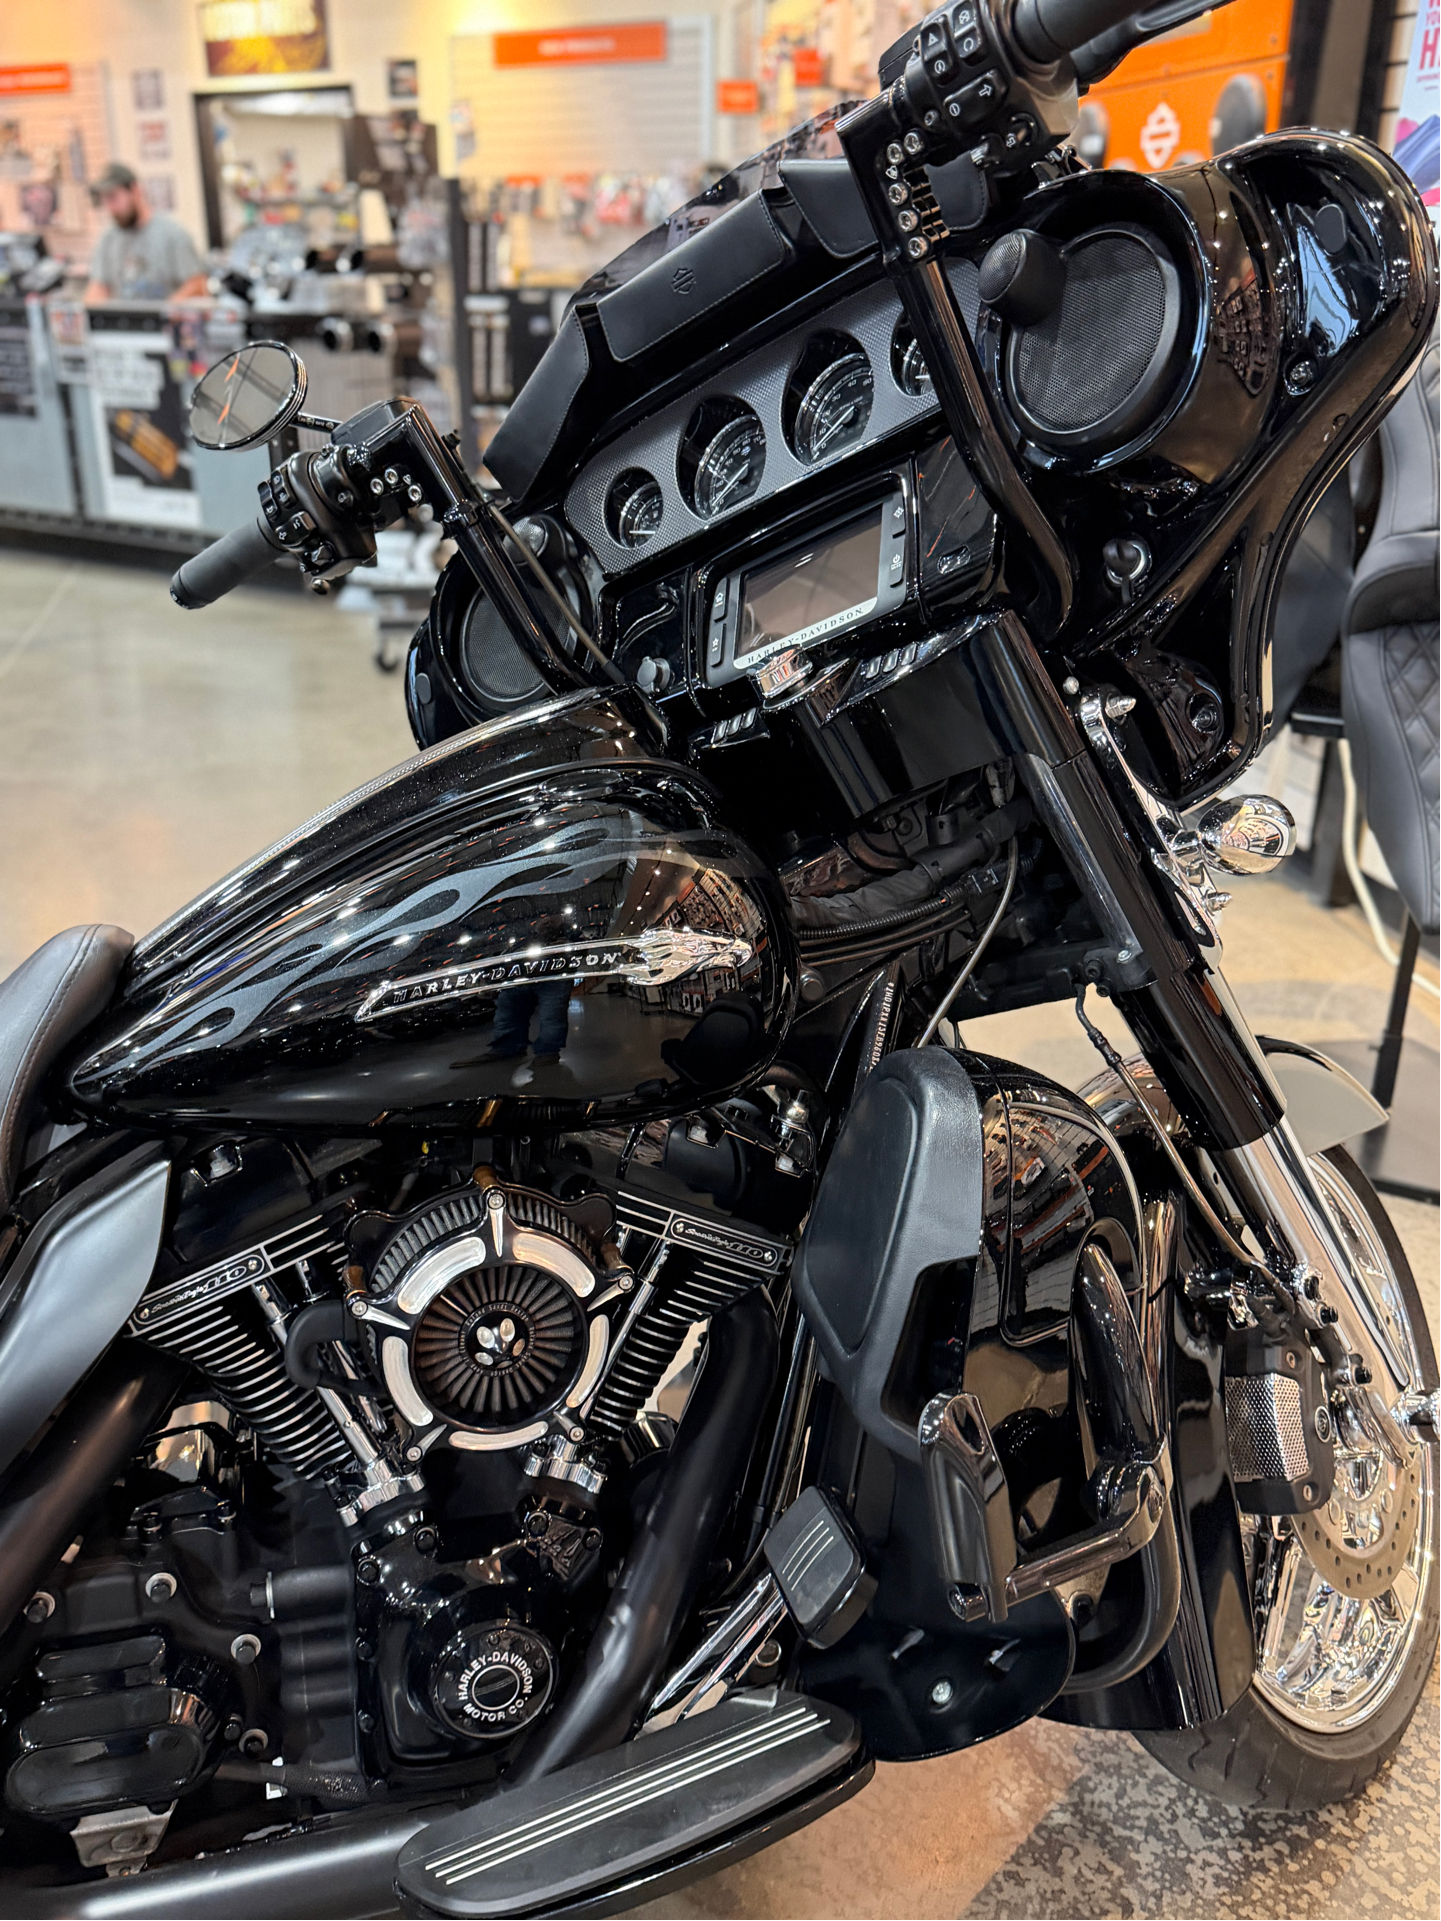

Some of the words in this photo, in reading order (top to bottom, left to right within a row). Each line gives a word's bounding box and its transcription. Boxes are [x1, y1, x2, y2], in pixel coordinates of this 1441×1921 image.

[748, 608, 863, 663] HARLEY-DAVIDSON
[393, 952, 618, 1003] HARLEY-DAVIDSON
[726, 1242, 764, 1258] 110
[203, 1266, 247, 1293] 110
[458, 1651, 533, 1701] HARLEY-DAVIDSON
[463, 1702, 506, 1722] MOTOR
